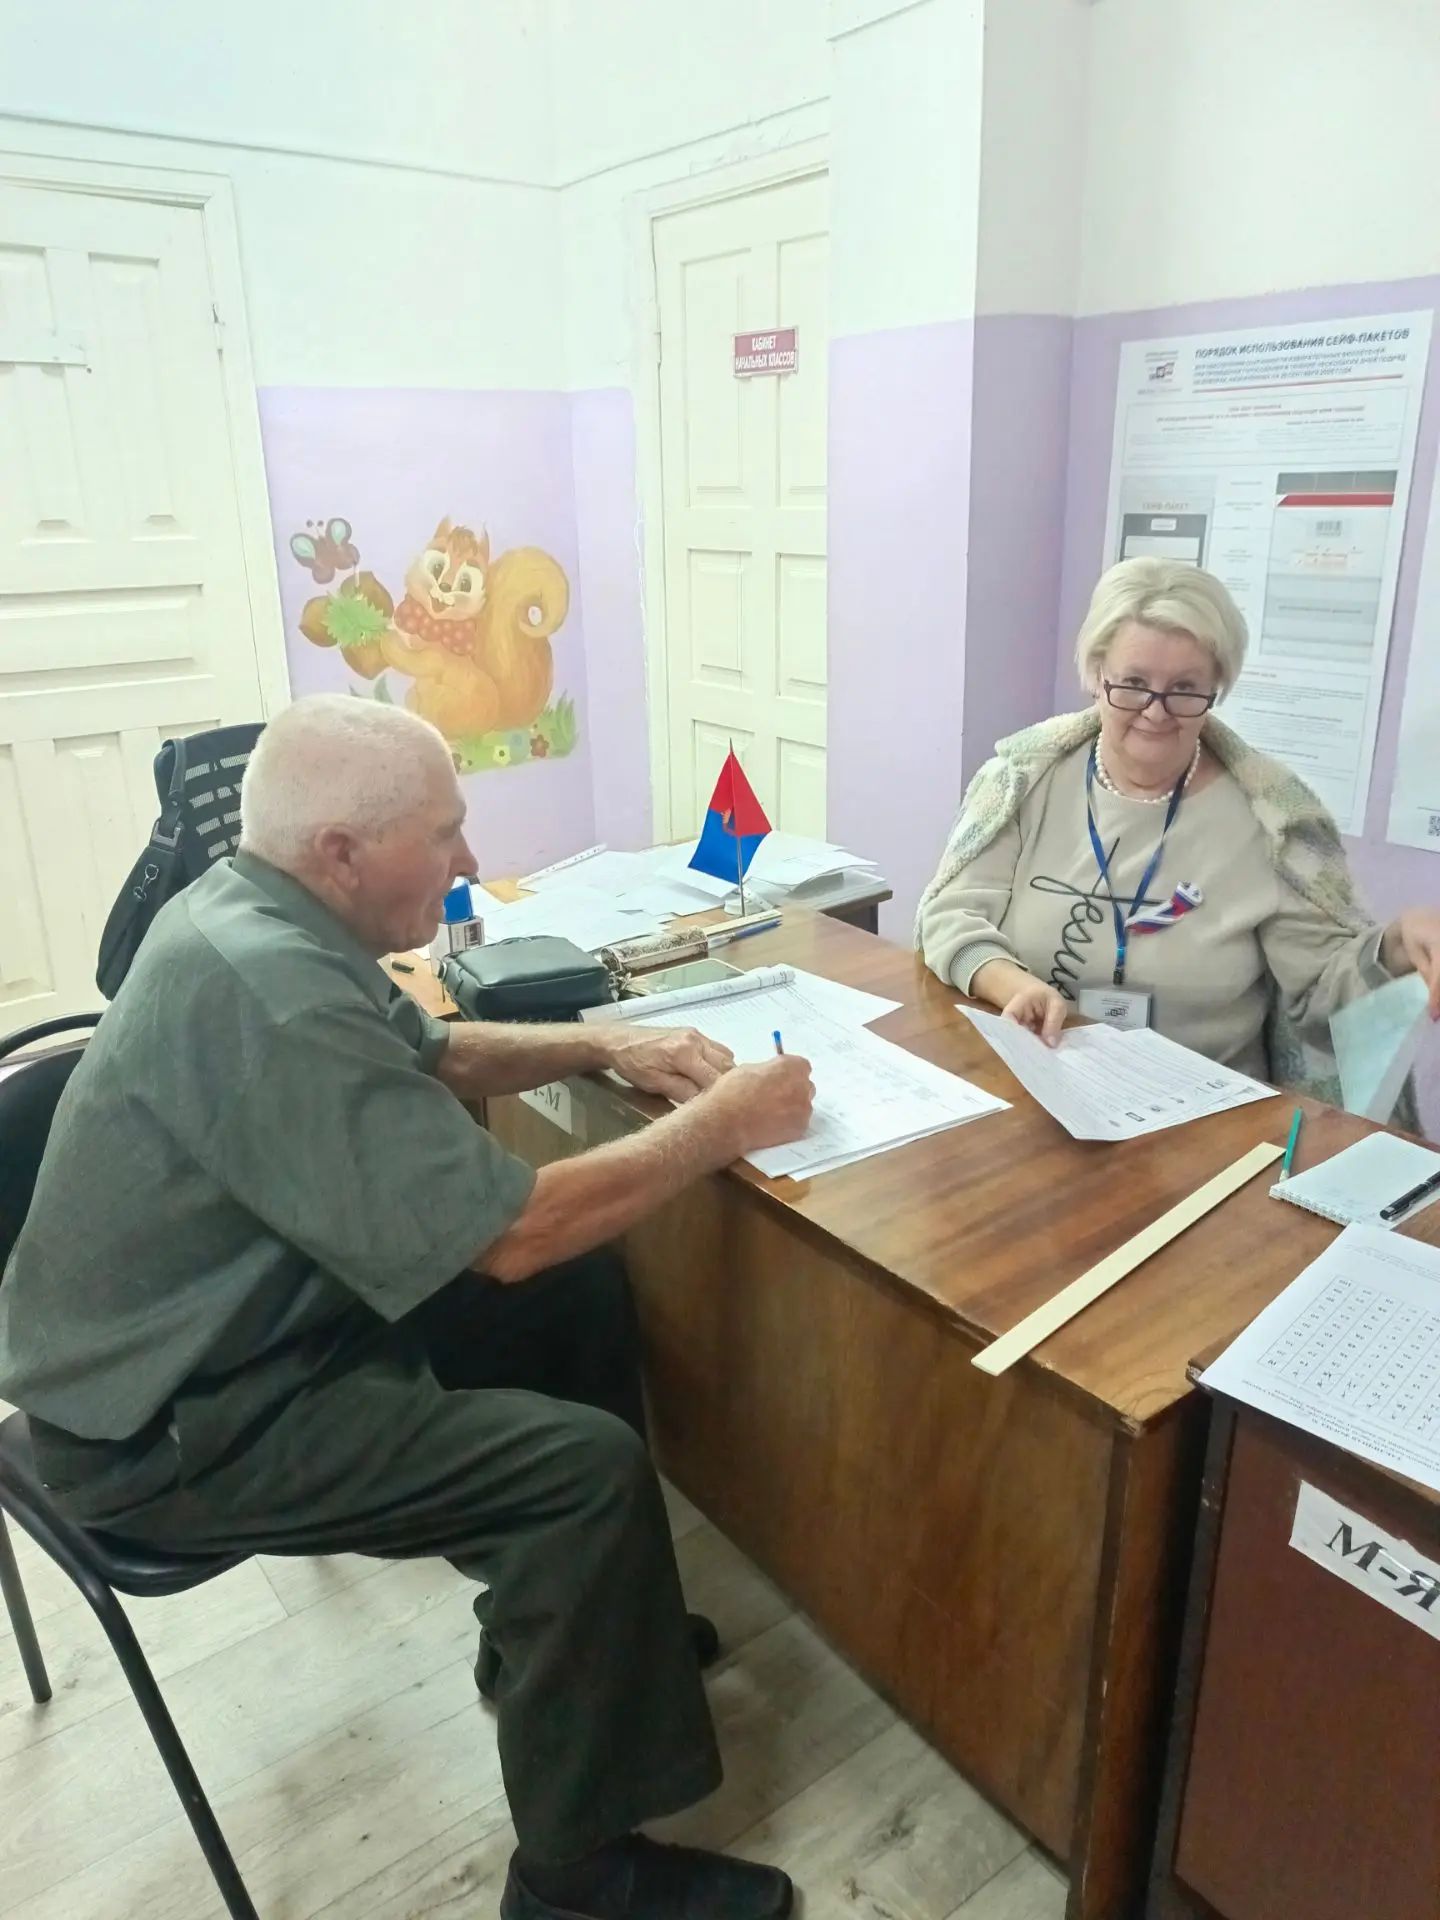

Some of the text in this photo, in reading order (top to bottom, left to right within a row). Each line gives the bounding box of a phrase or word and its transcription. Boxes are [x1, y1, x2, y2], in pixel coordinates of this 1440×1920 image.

[1194, 346, 1238, 358] ПОРЯДОК
[1239, 336, 1325, 354] ИСПОЛЬЗОВАНИЯ
[1325, 328, 1410, 347] СЕЙФ-ПАКЕТОВ
[769, 351, 795, 367] КЛАССОВ
[1323, 1519, 1440, 1614] М-Я
